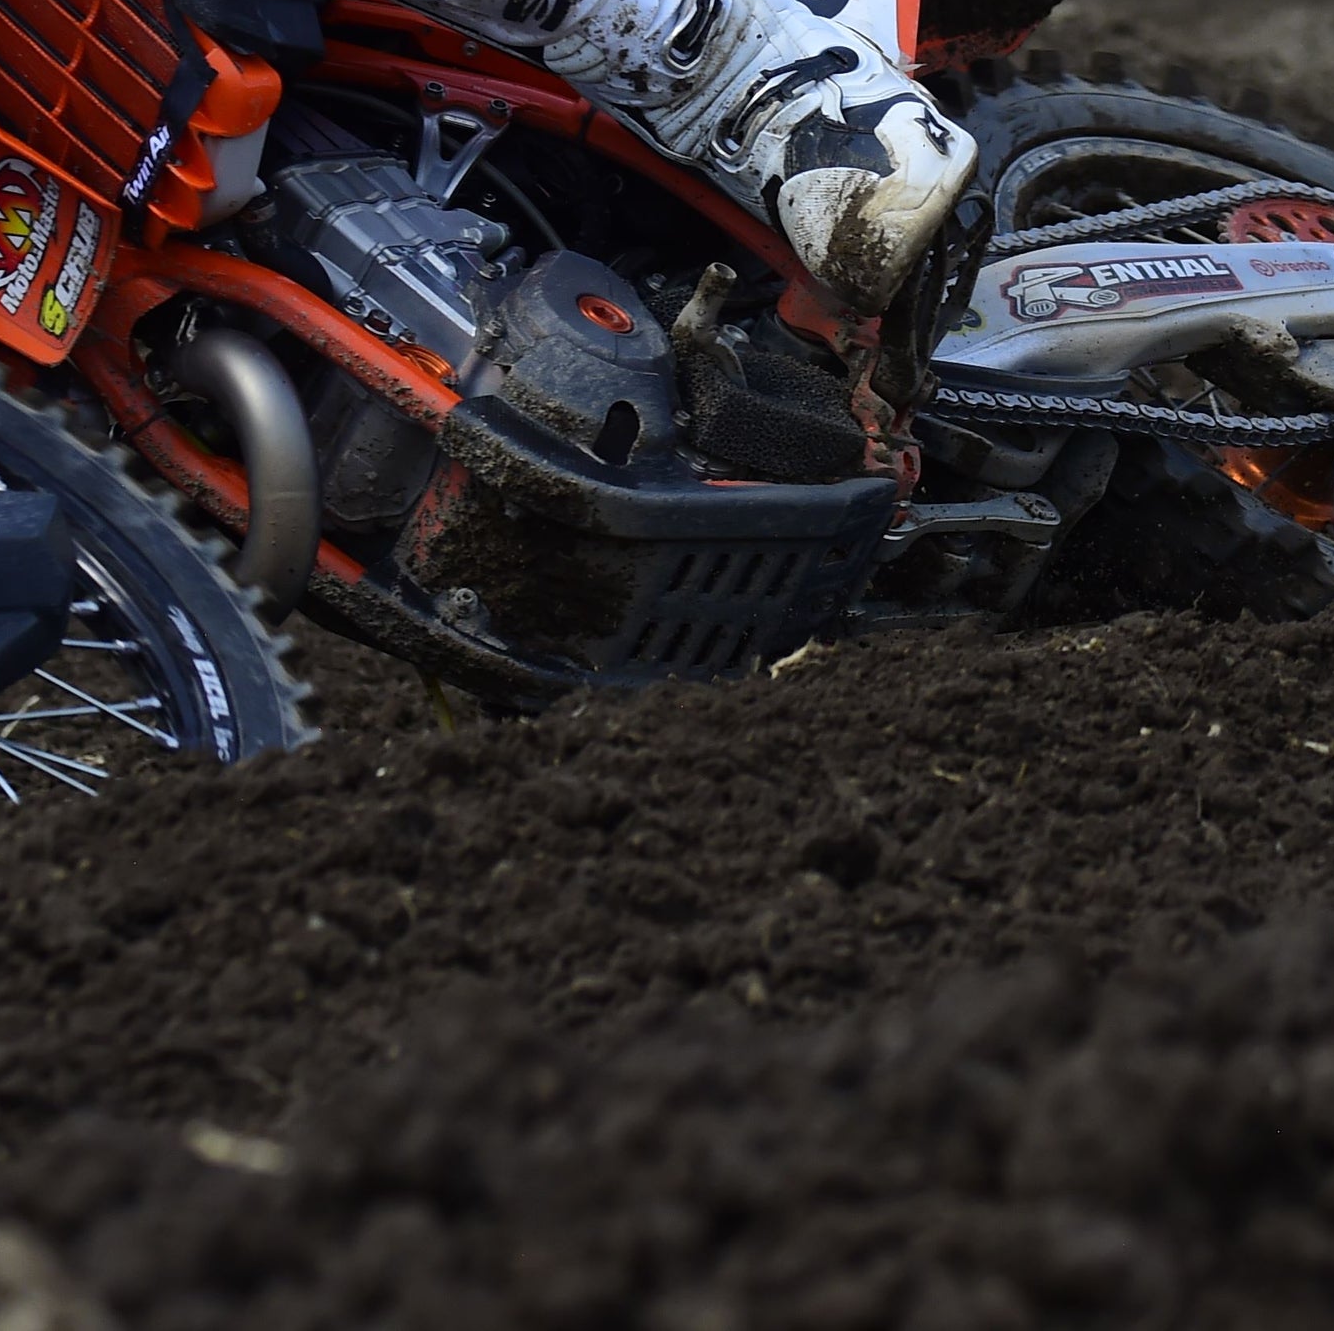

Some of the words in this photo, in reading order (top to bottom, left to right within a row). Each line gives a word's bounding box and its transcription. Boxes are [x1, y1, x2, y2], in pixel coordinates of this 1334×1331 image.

[123, 156, 154, 205] Twin
[149, 126, 170, 161] Air
[1274, 258, 1331, 274] brembo
